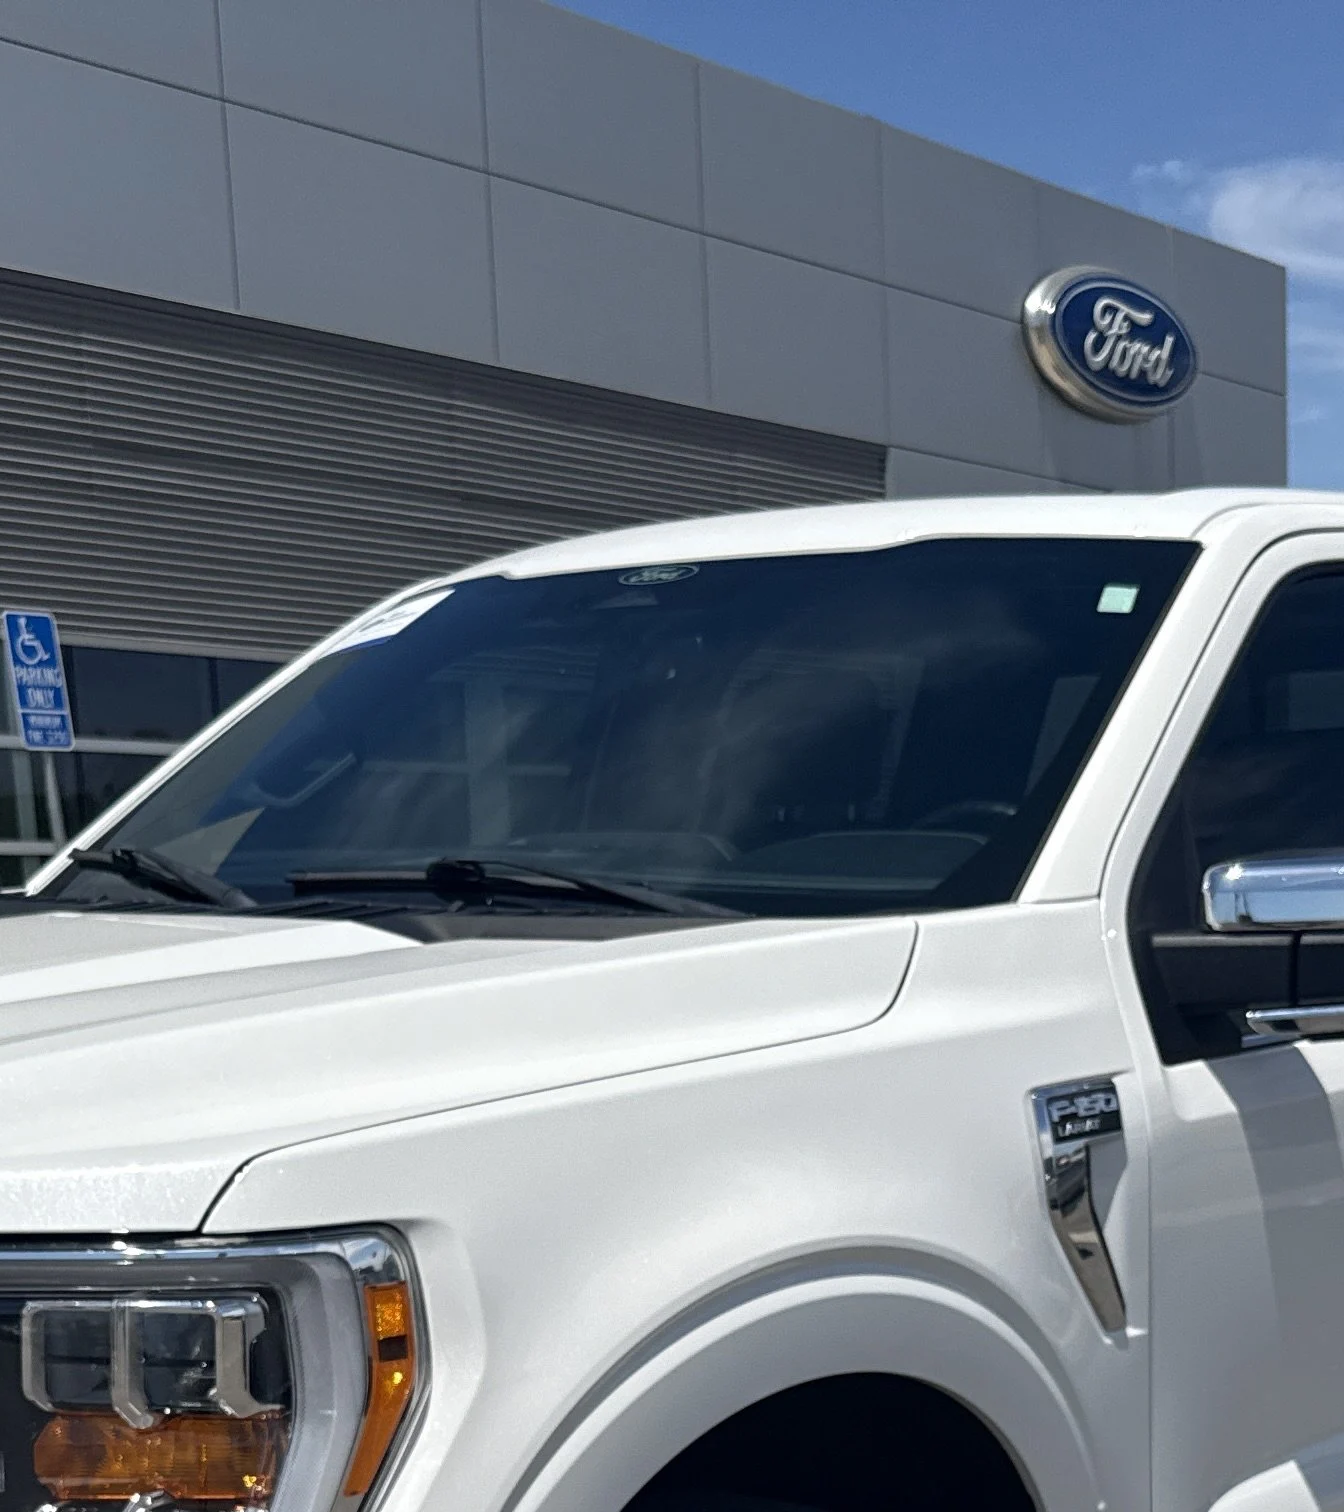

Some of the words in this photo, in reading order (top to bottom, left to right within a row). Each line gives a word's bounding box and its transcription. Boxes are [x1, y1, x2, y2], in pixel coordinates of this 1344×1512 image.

[1082, 294, 1176, 388] Ford
[14, 665, 63, 689] PARKING
[26, 687, 56, 709] ONLY
